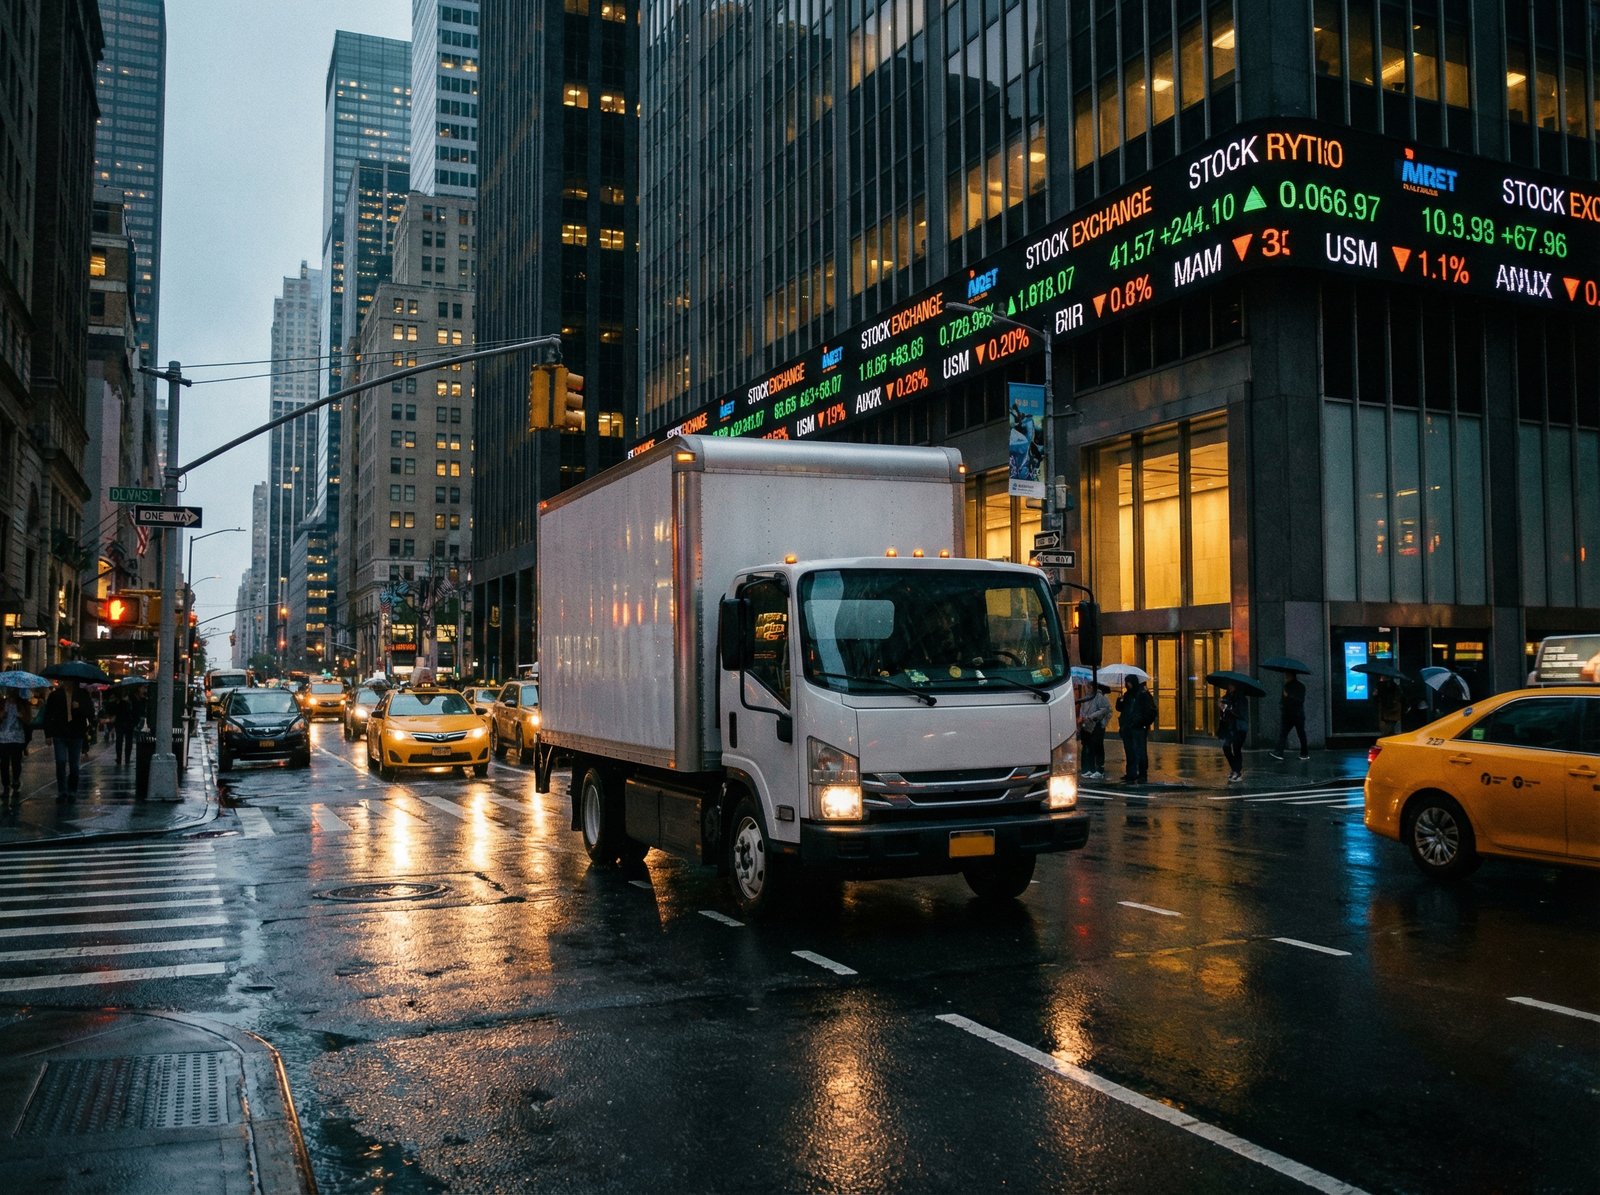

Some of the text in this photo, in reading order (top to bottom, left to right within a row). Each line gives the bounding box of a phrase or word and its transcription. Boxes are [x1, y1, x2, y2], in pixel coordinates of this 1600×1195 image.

[1189, 135, 1259, 189] STOCK
[1279, 181, 1381, 222] 0.066.97
[1503, 178, 1566, 215] STOCK
[1026, 186, 1152, 270] STOCK EXCHANGE
[1109, 193, 1235, 270] 41.57 +244.10
[1501, 225, 1568, 258] +67.96
[1174, 244, 1222, 287] MAM
[1326, 233, 1470, 284] USM 1.1%
[861, 292, 943, 350] STOCK EXCHANGE
[943, 327, 1029, 379] USM 0.20%
[747, 362, 805, 405] STOCK EXCHANGE
[896, 368, 929, 397] 0.26%
[796, 414, 815, 437] USM
[144, 511, 193, 521] ONE WAY
